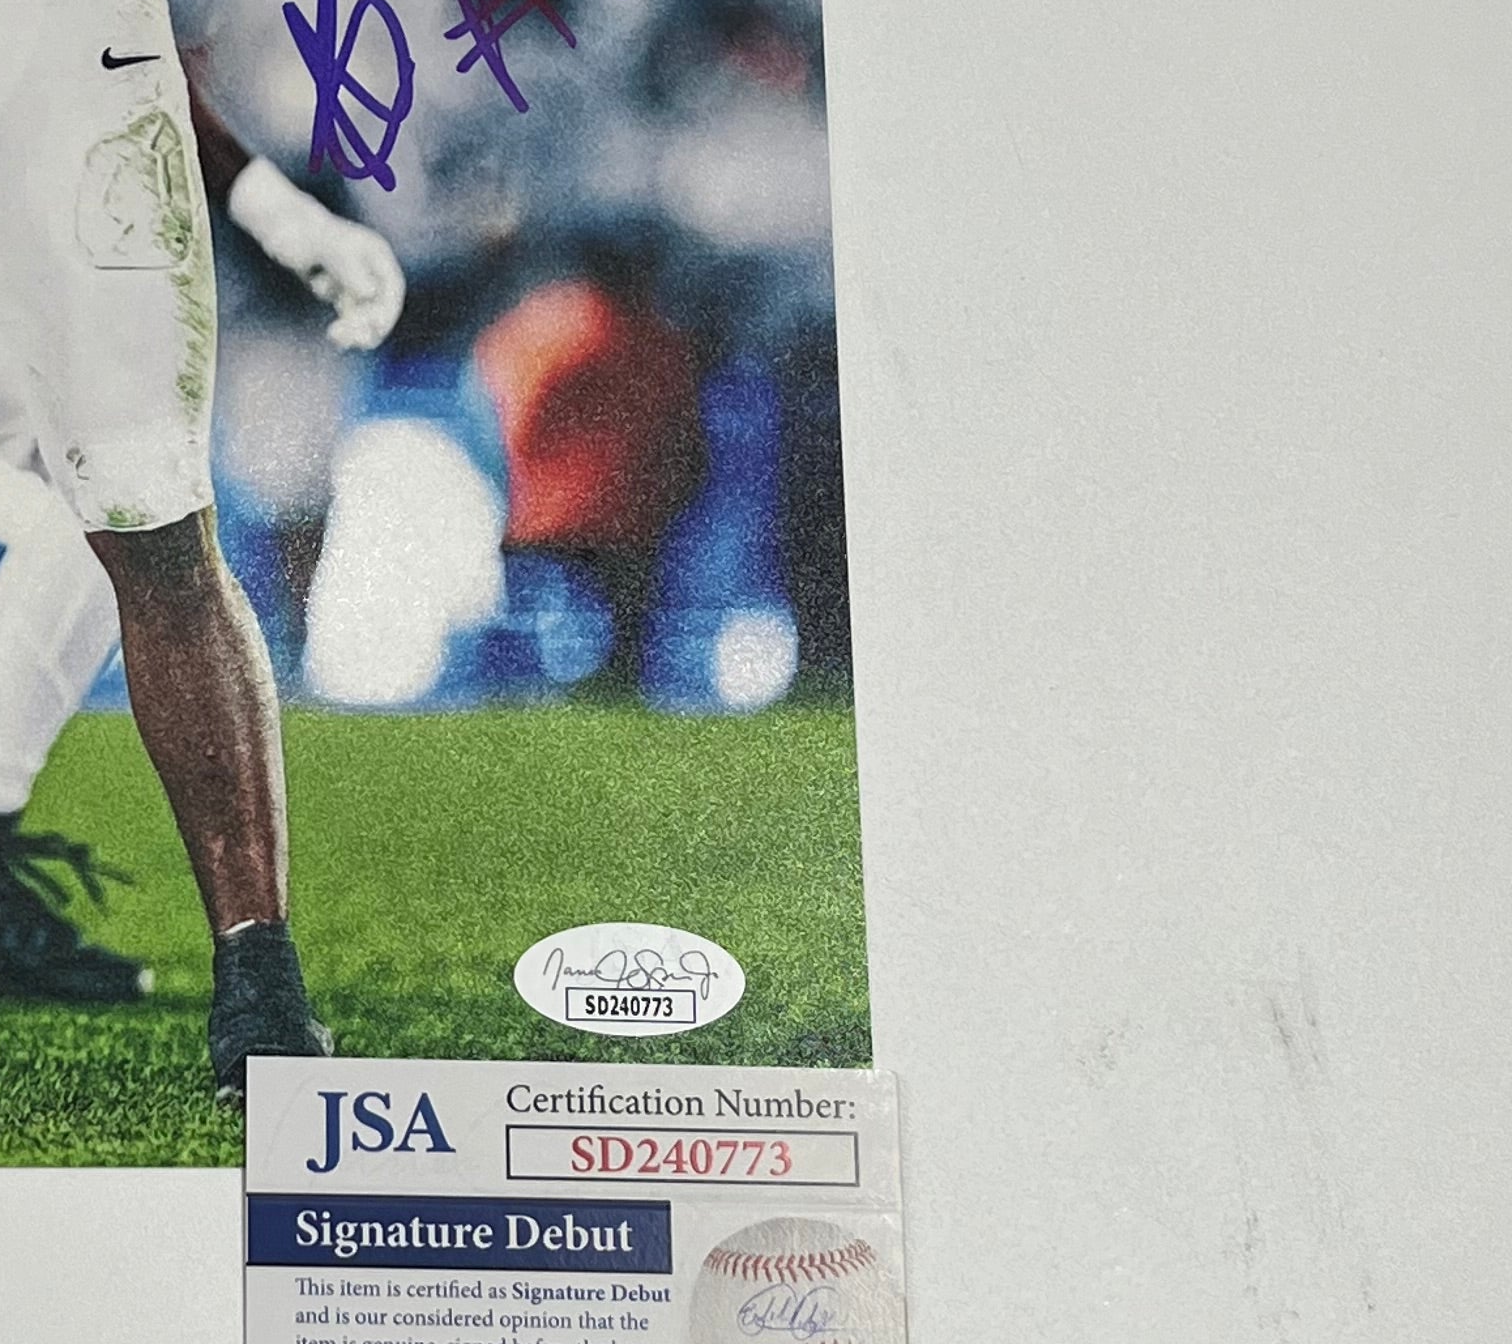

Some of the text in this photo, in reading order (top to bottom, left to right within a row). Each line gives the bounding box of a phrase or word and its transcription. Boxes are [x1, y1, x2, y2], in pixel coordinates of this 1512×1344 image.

[585, 994, 673, 1017] SD240773
[506, 1084, 856, 1119] Certification Number:
[306, 1091, 456, 1173] JSA
[571, 1136, 792, 1176] SD240773
[296, 1210, 633, 1258] Signature Debut
[295, 1277, 671, 1304] This item is certified as Signature Debut
[295, 1306, 649, 1333] and is our considered opinion that the
